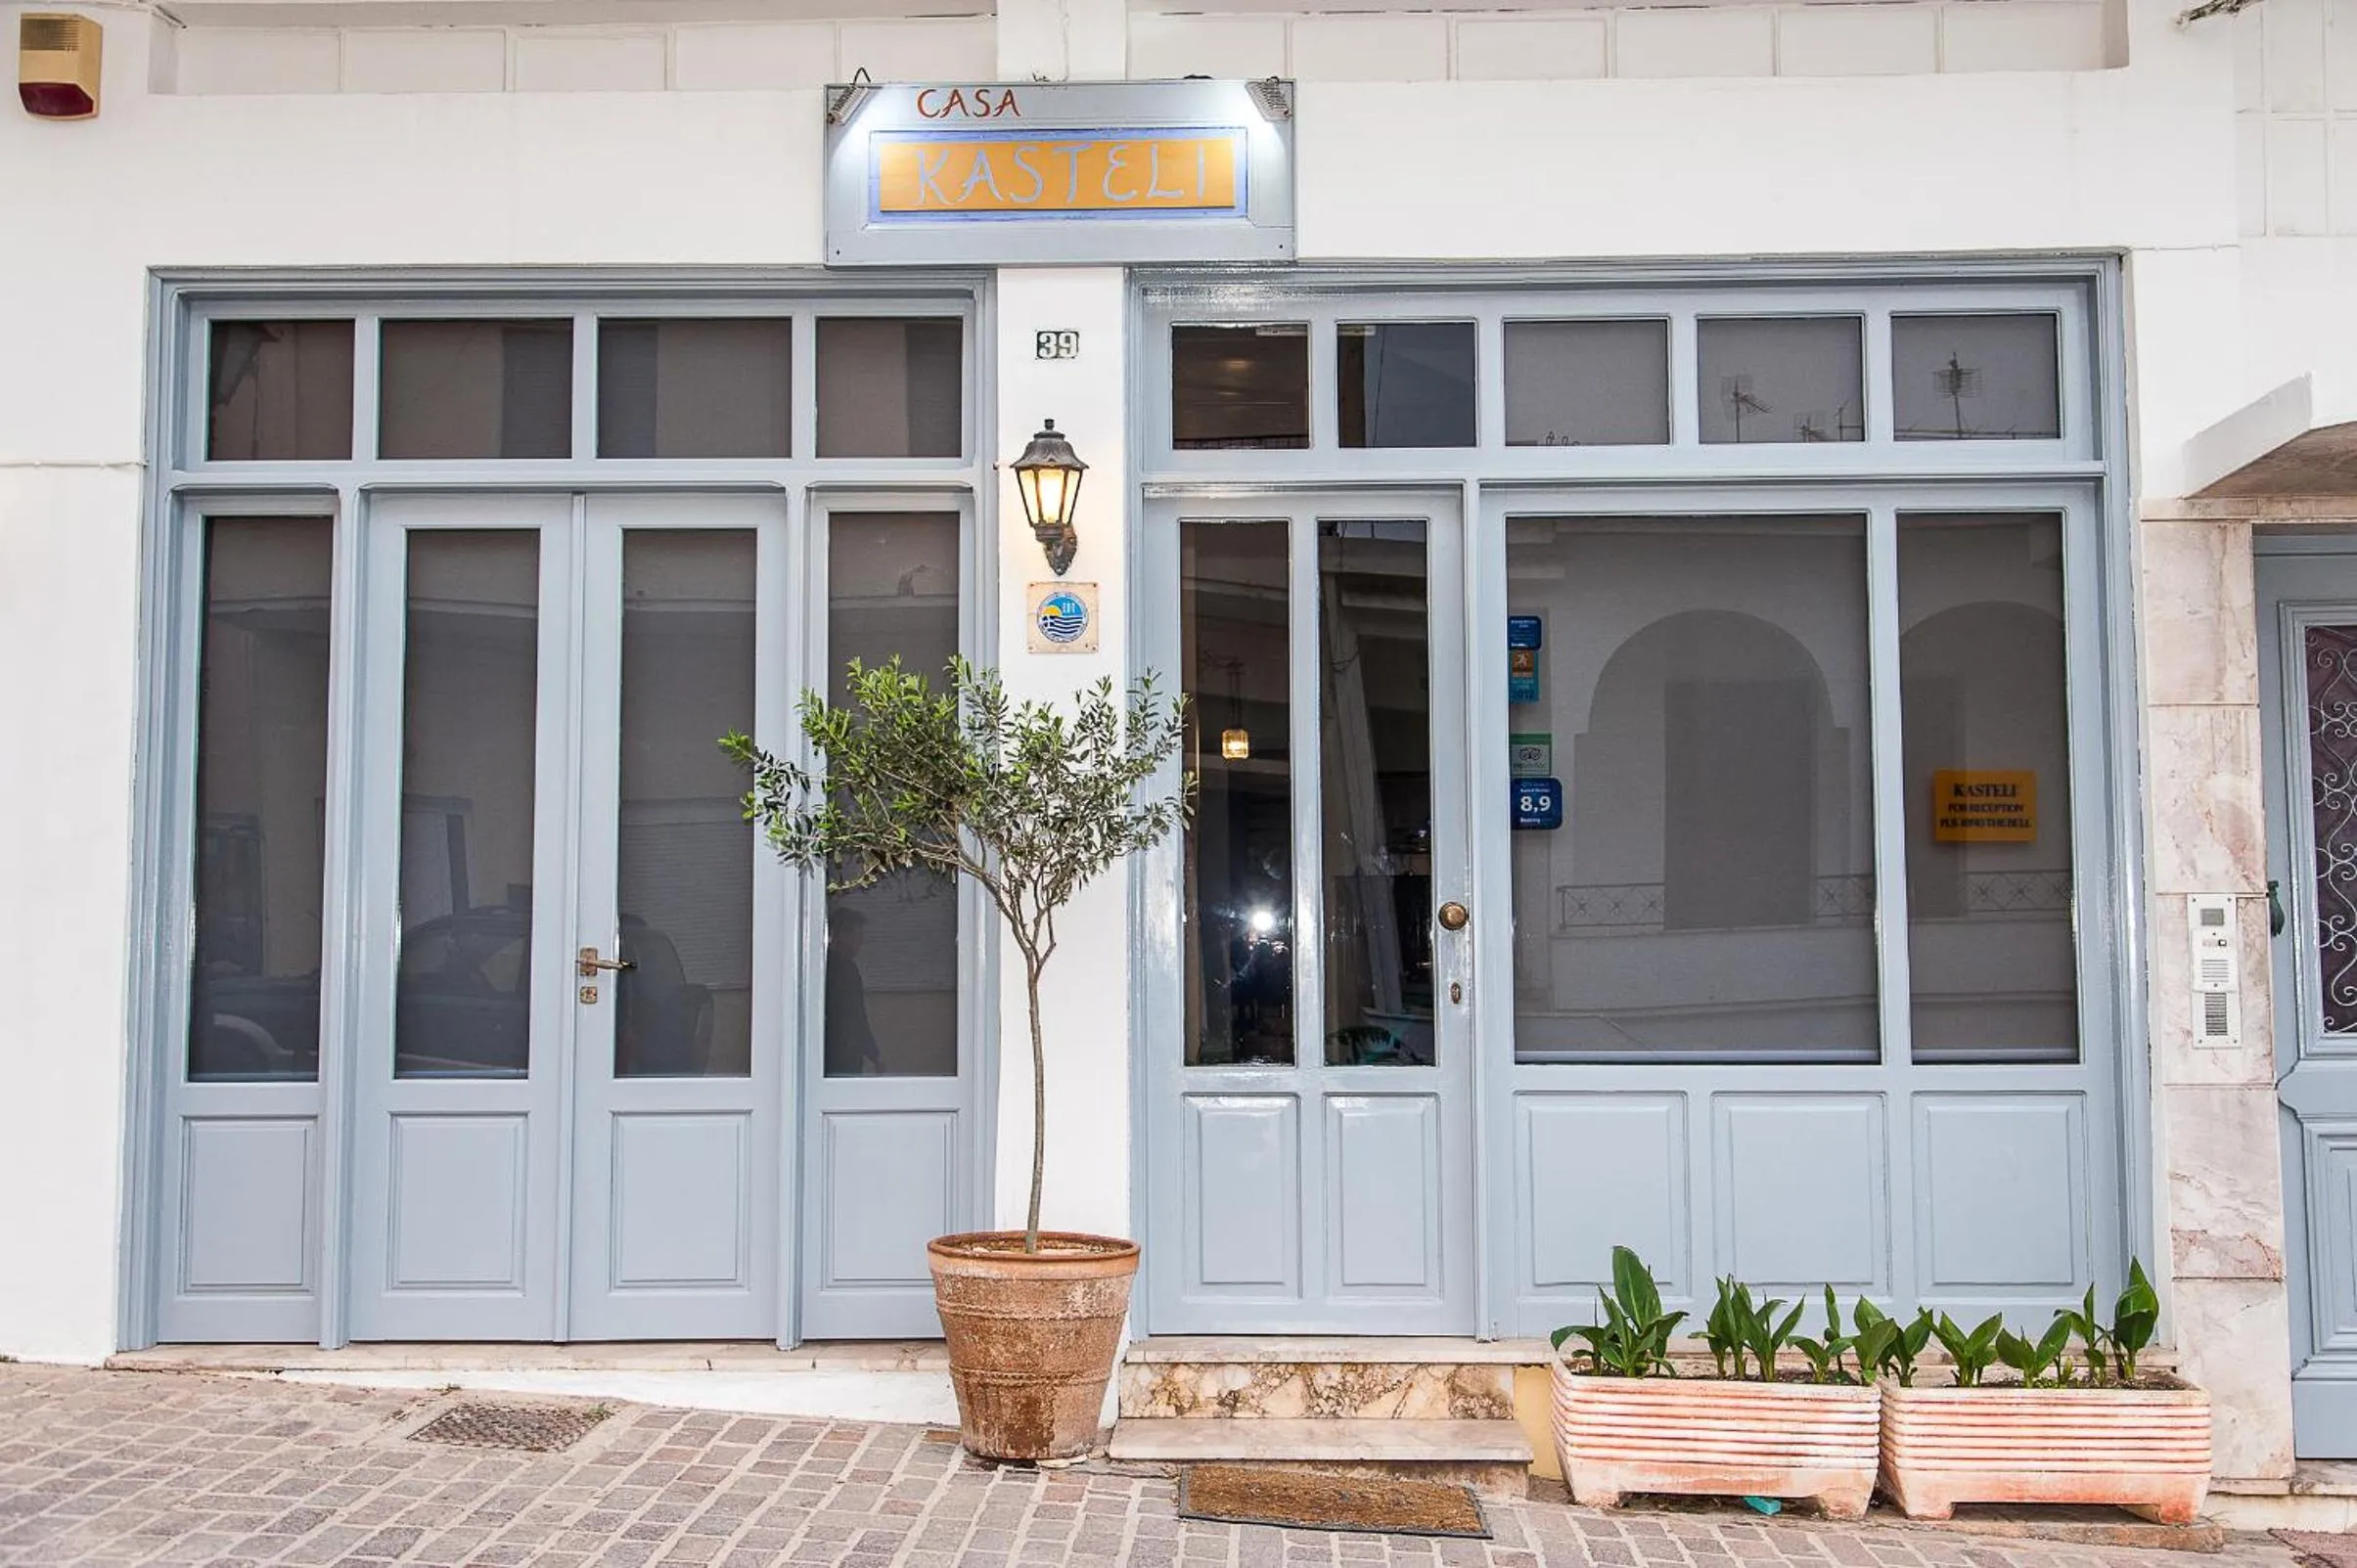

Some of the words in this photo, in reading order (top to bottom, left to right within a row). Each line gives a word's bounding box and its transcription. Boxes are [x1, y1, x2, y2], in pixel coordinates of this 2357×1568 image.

[917, 89, 1021, 118] CASA
[915, 144, 1205, 206] KASTELI
[1037, 332, 1078, 358] 39
[1953, 784, 2017, 797] KASTELI
[1519, 795, 1552, 813] 8,9
